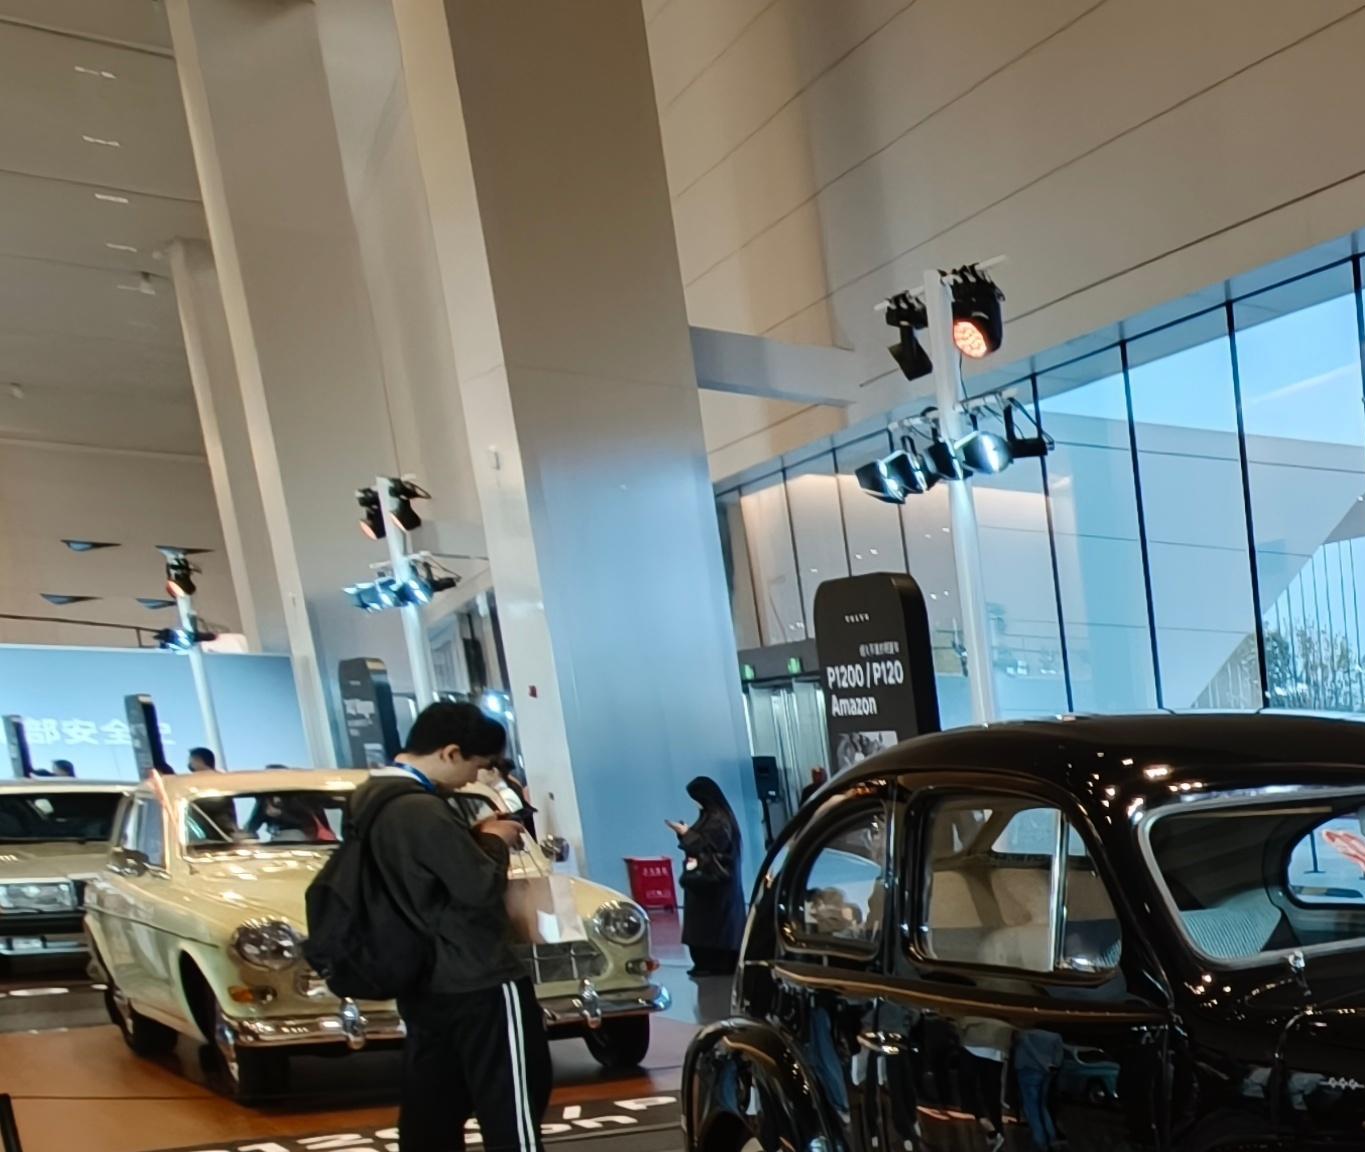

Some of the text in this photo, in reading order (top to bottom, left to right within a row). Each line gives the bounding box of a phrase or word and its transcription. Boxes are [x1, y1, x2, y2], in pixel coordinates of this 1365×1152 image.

[826, 663, 865, 690] P1200
[872, 659, 905, 686] P120
[830, 693, 878, 718] Amazon
